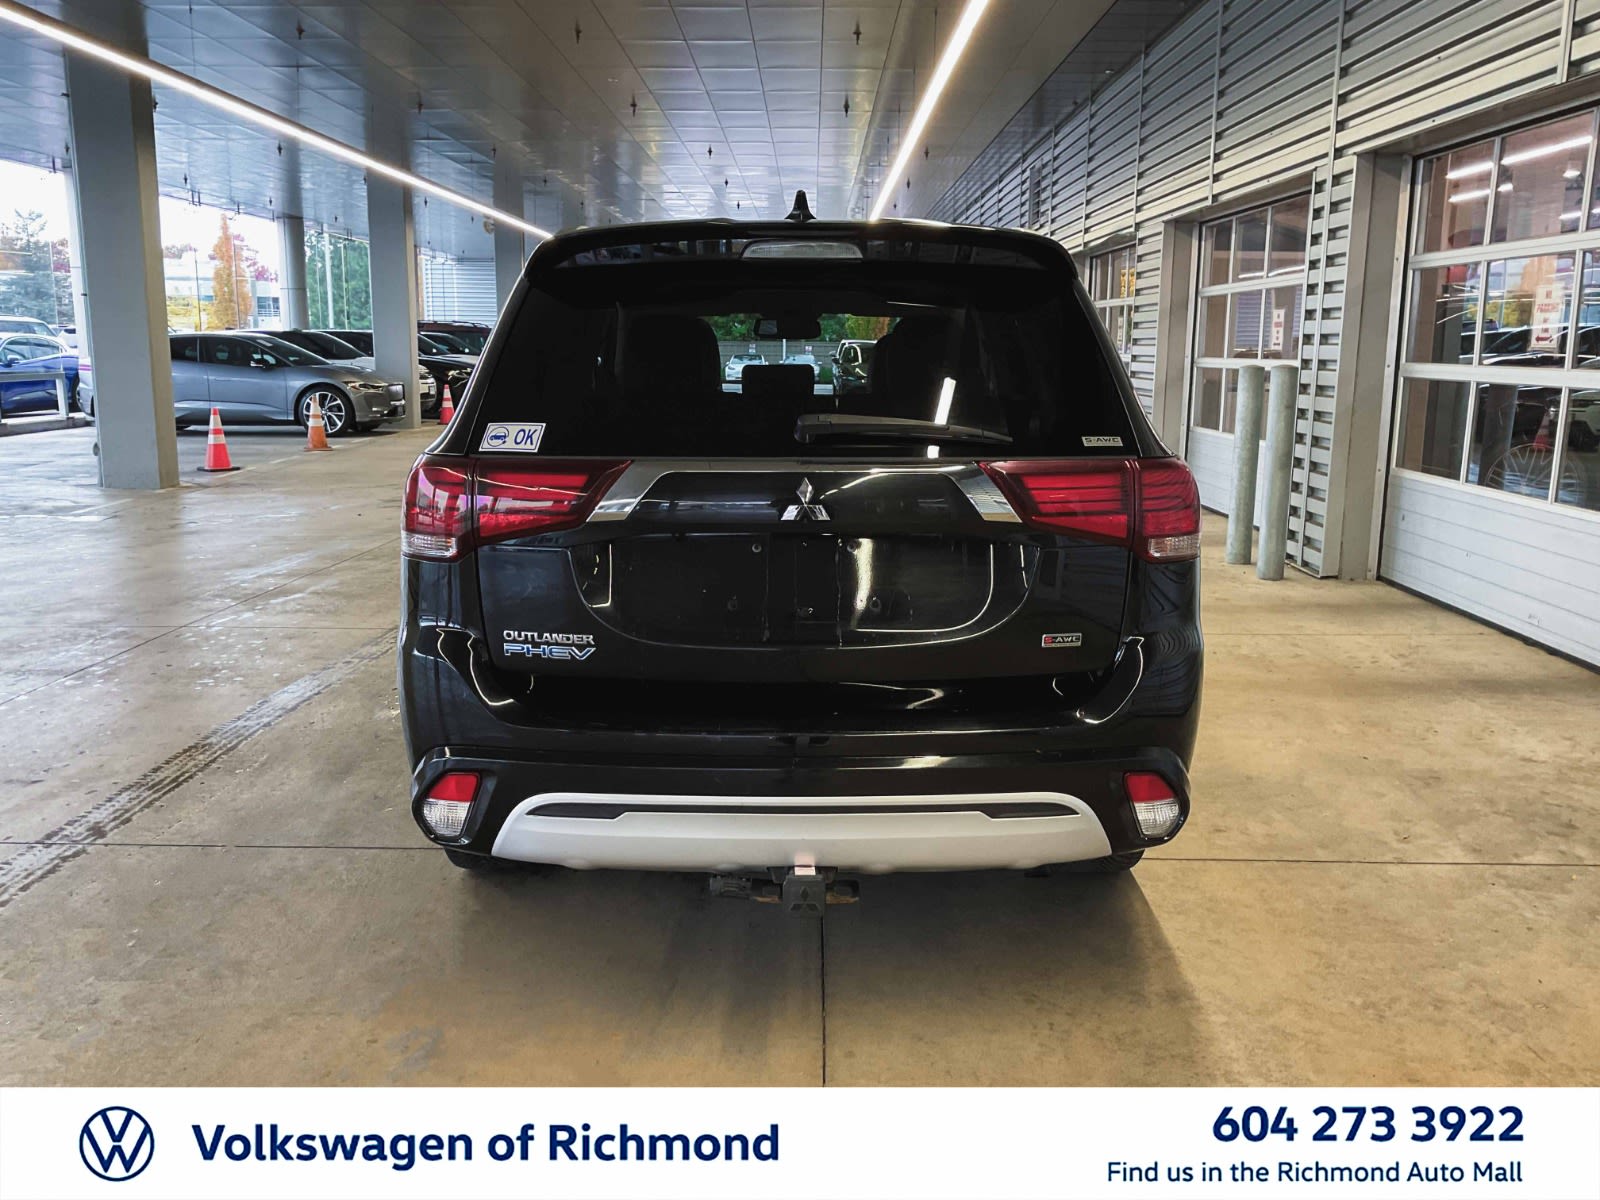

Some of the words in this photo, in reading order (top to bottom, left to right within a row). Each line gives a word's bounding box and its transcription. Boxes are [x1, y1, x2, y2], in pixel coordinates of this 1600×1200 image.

[514, 428, 538, 446] OK
[503, 630, 595, 645] OUTLANDER
[1044, 635, 1081, 644] S-AWC
[503, 643, 597, 660] PHEV
